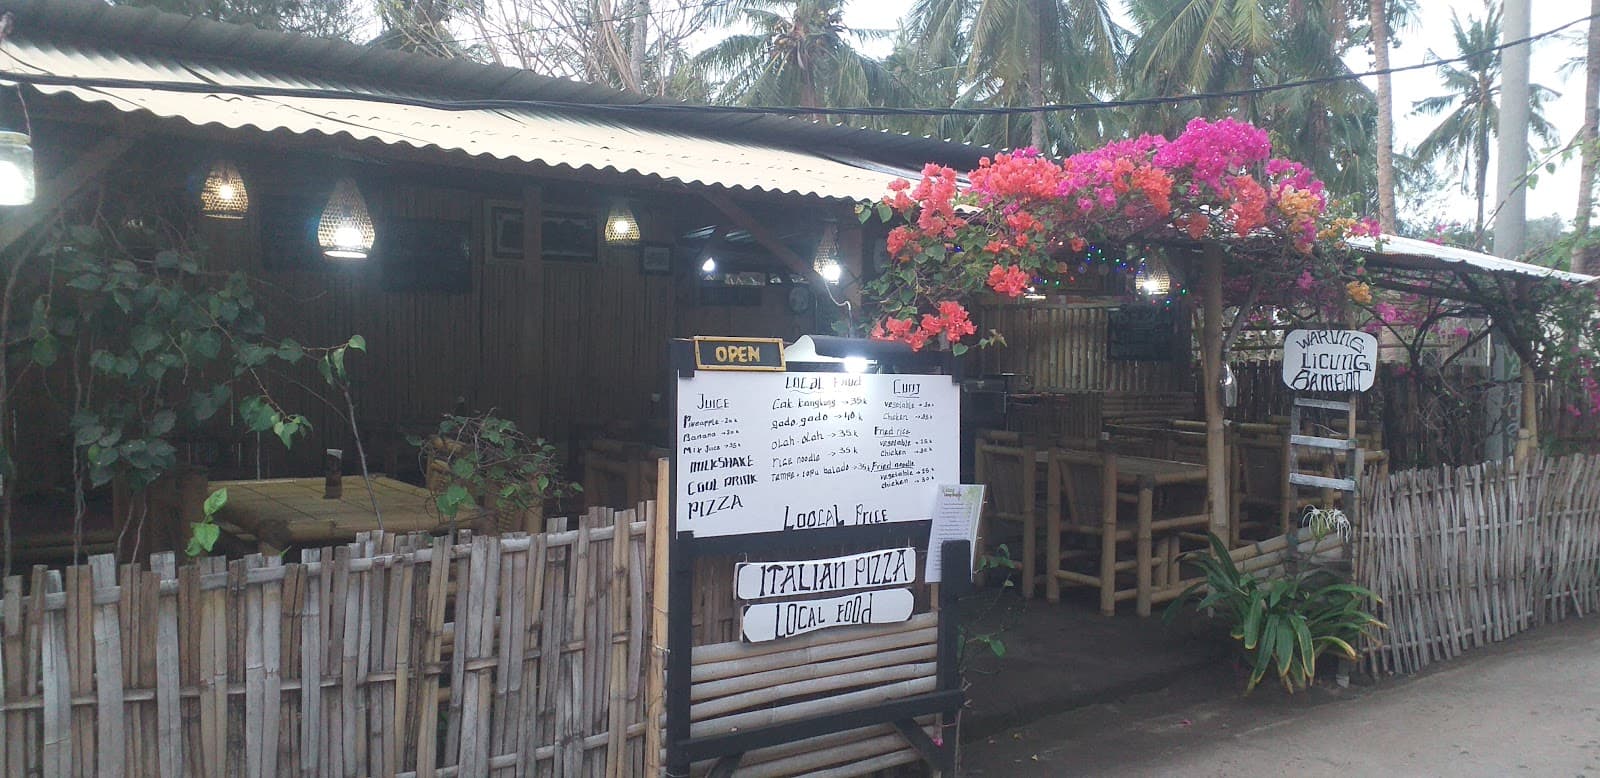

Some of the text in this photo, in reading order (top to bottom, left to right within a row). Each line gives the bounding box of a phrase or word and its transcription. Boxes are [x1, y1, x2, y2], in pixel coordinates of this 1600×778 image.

[715, 346, 761, 363] OPEN
[690, 455, 754, 473] MILKSHAKE
[688, 494, 744, 520] PIZZA
[853, 549, 908, 586] PIZZA
[775, 604, 826, 638] LOCAL
